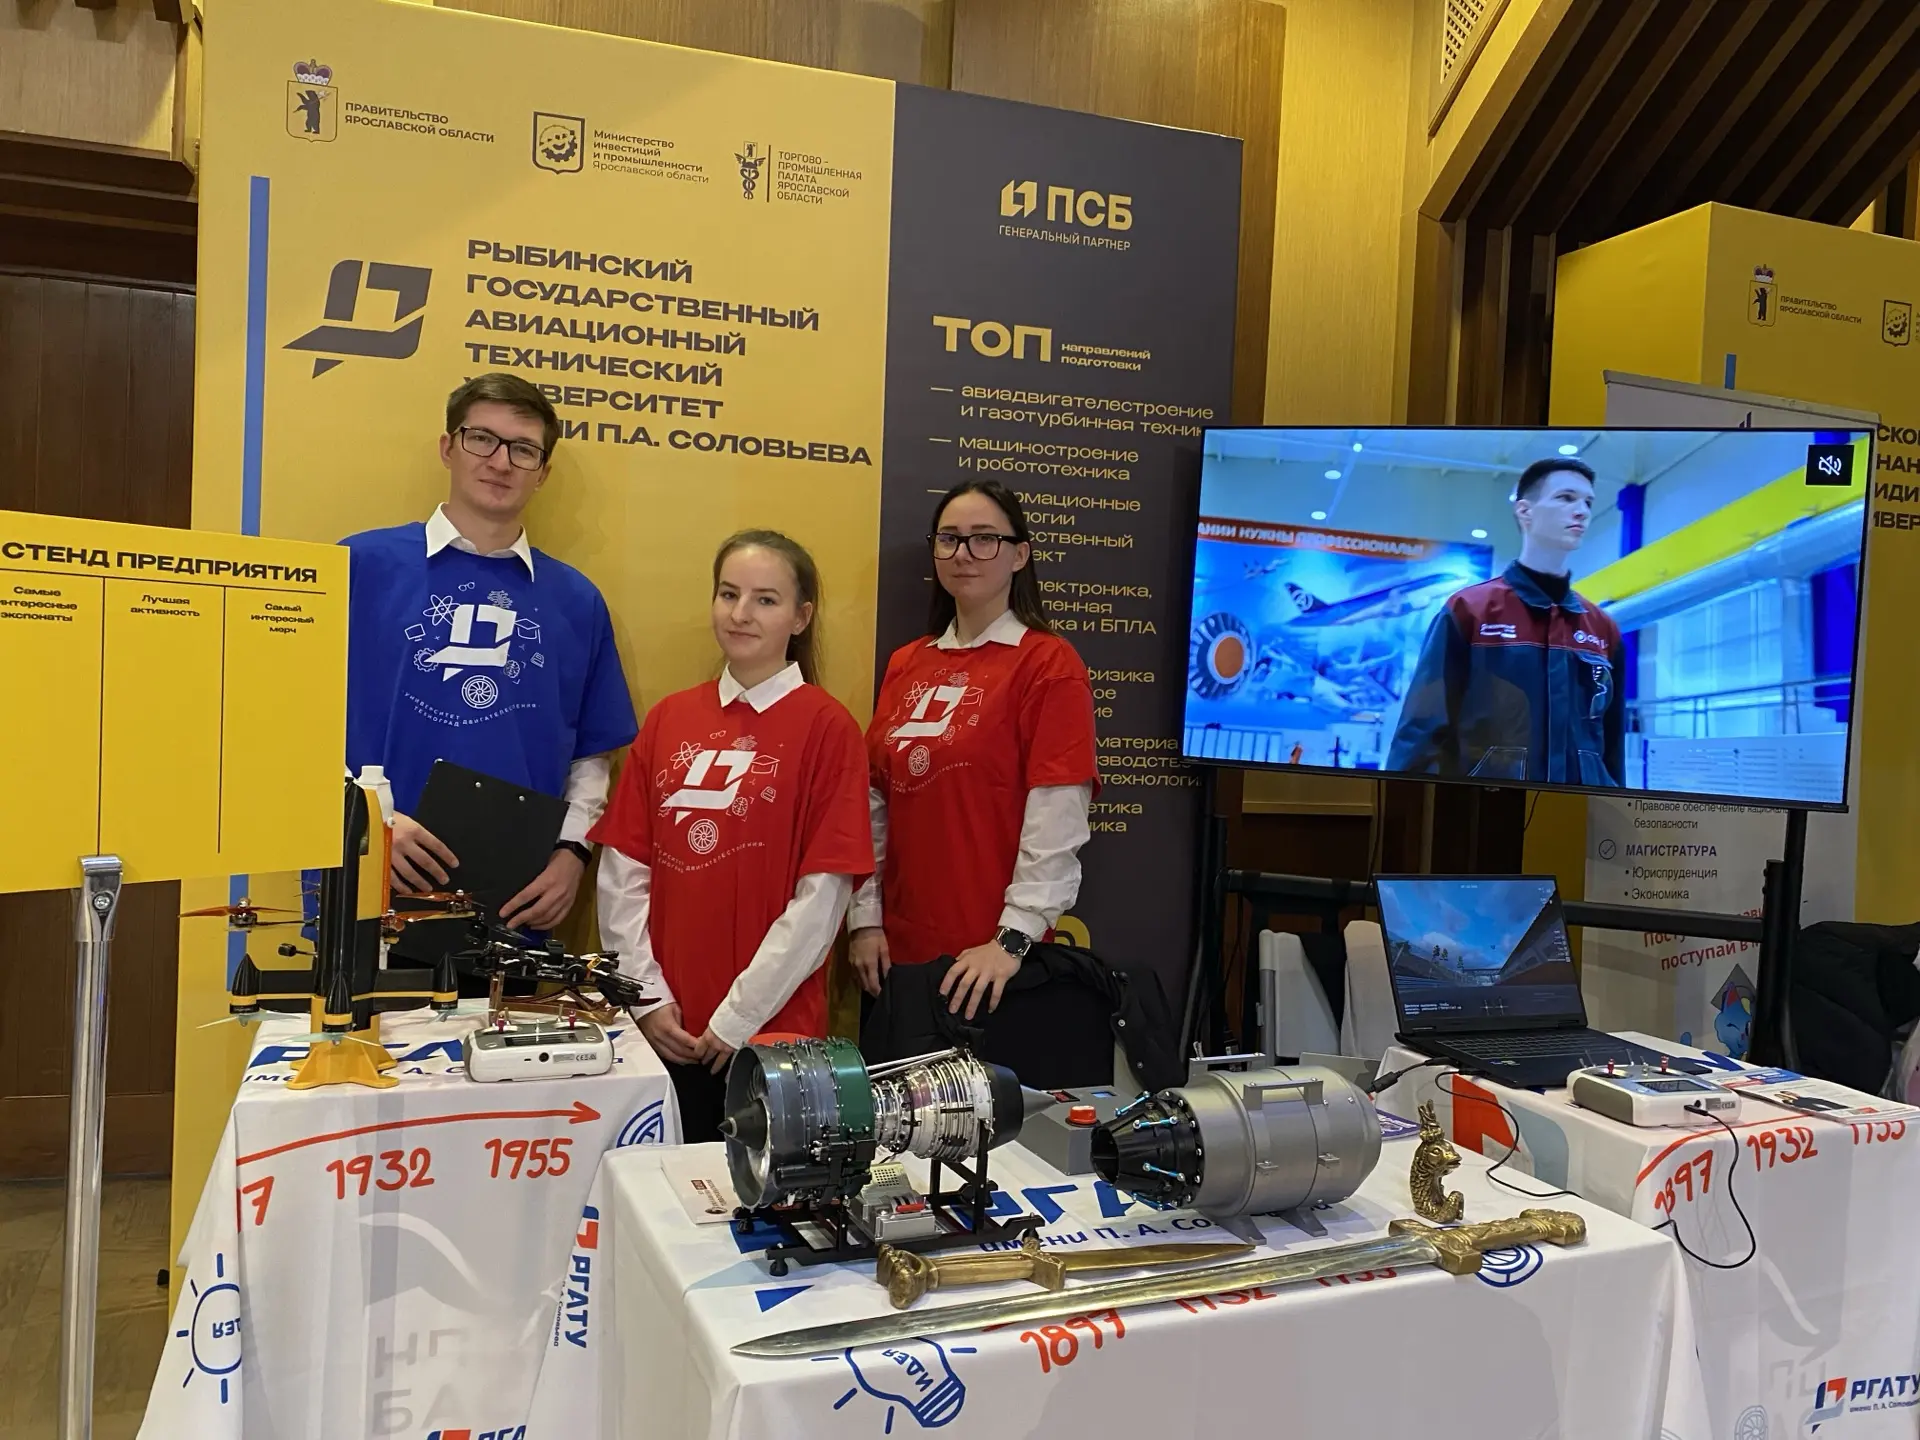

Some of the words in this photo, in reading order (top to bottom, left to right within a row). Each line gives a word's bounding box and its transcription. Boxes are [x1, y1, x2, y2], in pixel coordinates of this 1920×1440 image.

[345, 102, 449, 125] ПРАВИТЕЛЬСТВО
[344, 114, 436, 135] ЯРОСЛАВСКОЙ
[438, 127, 495, 143] ОБЛАСТИ
[593, 129, 675, 150] Министерство
[593, 142, 661, 158] инвестиций
[592, 151, 601, 161] и
[602, 152, 703, 173] промышленности
[777, 150, 822, 165] ТОРГОВО
[592, 160, 664, 178] Ярославской
[665, 171, 710, 184] области
[777, 161, 863, 181] ПРОМЫШЛЕННАЯ
[777, 171, 818, 185] ПАЛАТА
[776, 181, 850, 199] ЯРОСЛАВСКОЙ
[776, 191, 824, 205] ОБЛАСТИ
[1047, 185, 1134, 231] ПСБ
[998, 225, 1081, 246] ГЕНЕРАЛЬНЫЙ
[1082, 235, 1131, 252] ПАРТНЕР
[467, 239, 693, 285] РЫБИНСКИЙ
[466, 273, 820, 332] ГОСУДАРСТВЕННЫЙ
[1780, 295, 1837, 311] ПРАВИТЕЛЬСТВО
[1779, 305, 1830, 320] ЯРОСЛАВСКОЙ
[1830, 312, 1862, 325] ОБЛАСТИ
[464, 308, 747, 356] АВИАЦИОННЫЙ
[932, 315, 1053, 363] ТОП
[1061, 342, 1152, 361] направлений
[464, 342, 724, 387] ТЕХНИЧЕСКИЙ
[1060, 355, 1142, 372] подготовки
[538, 383, 725, 420] ВЕРСИТЕТ
[961, 384, 1214, 420] авиадвигателестроение
[960, 405, 974, 418] и
[979, 405, 1135, 432] газотурбинная
[597, 422, 661, 448] П.А.
[667, 429, 874, 466] СОЛОВЬЕВА
[958, 435, 1139, 463] машиностроение
[958, 455, 972, 469] и
[976, 456, 1131, 481] робототехника
[1, 541, 110, 569] СТЕНД
[116, 550, 318, 583] ПРЕДПРИЯТИЯ
[13, 585, 62, 597] Самые
[141, 594, 191, 606] Лучшая
[0, 611, 74, 622] экспонаты
[130, 606, 201, 618] активность
[264, 602, 302, 613] Самый
[250, 613, 315, 625] интересный
[1082, 620, 1095, 632] и
[1100, 618, 1157, 635] БПЛА
[269, 625, 297, 635] мерч
[1633, 800, 1680, 813] Правовое
[1633, 818, 1699, 830] безопасности
[1625, 844, 1718, 858] МАГИСТРАТУРА
[1631, 866, 1718, 881] Юриспруденция
[1631, 888, 1690, 900] Экономика
[1746, 1126, 1819, 1172] 1932
[326, 1147, 436, 1201] 1932
[484, 1138, 574, 1181] 1955
[564, 1254, 591, 1350] РГАТУ
[1020, 1307, 1127, 1374] 1897
[1850, 1374, 1920, 1402] РГАТУ
